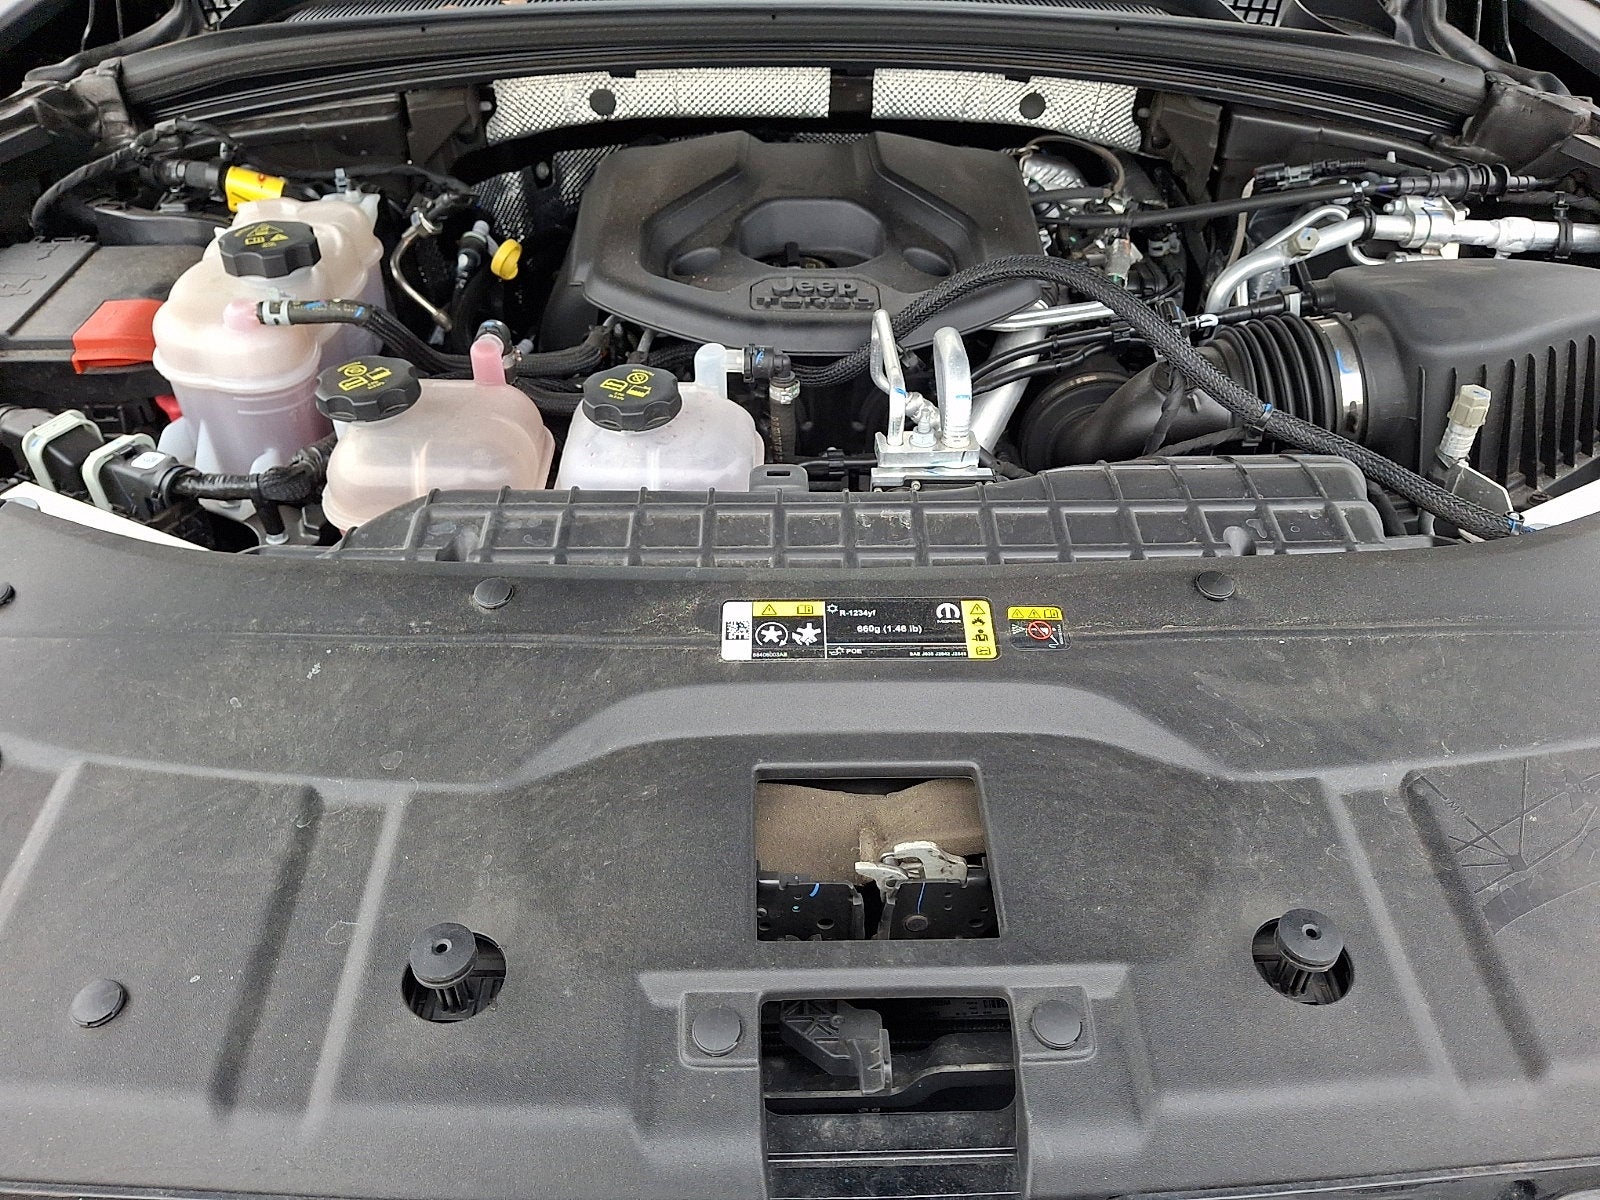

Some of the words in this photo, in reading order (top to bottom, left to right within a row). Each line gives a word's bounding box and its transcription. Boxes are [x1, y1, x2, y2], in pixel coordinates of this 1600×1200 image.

[771, 277, 858, 298] Jeep
[856, 624, 881, 634] 660g
[909, 624, 922, 634] lb)
